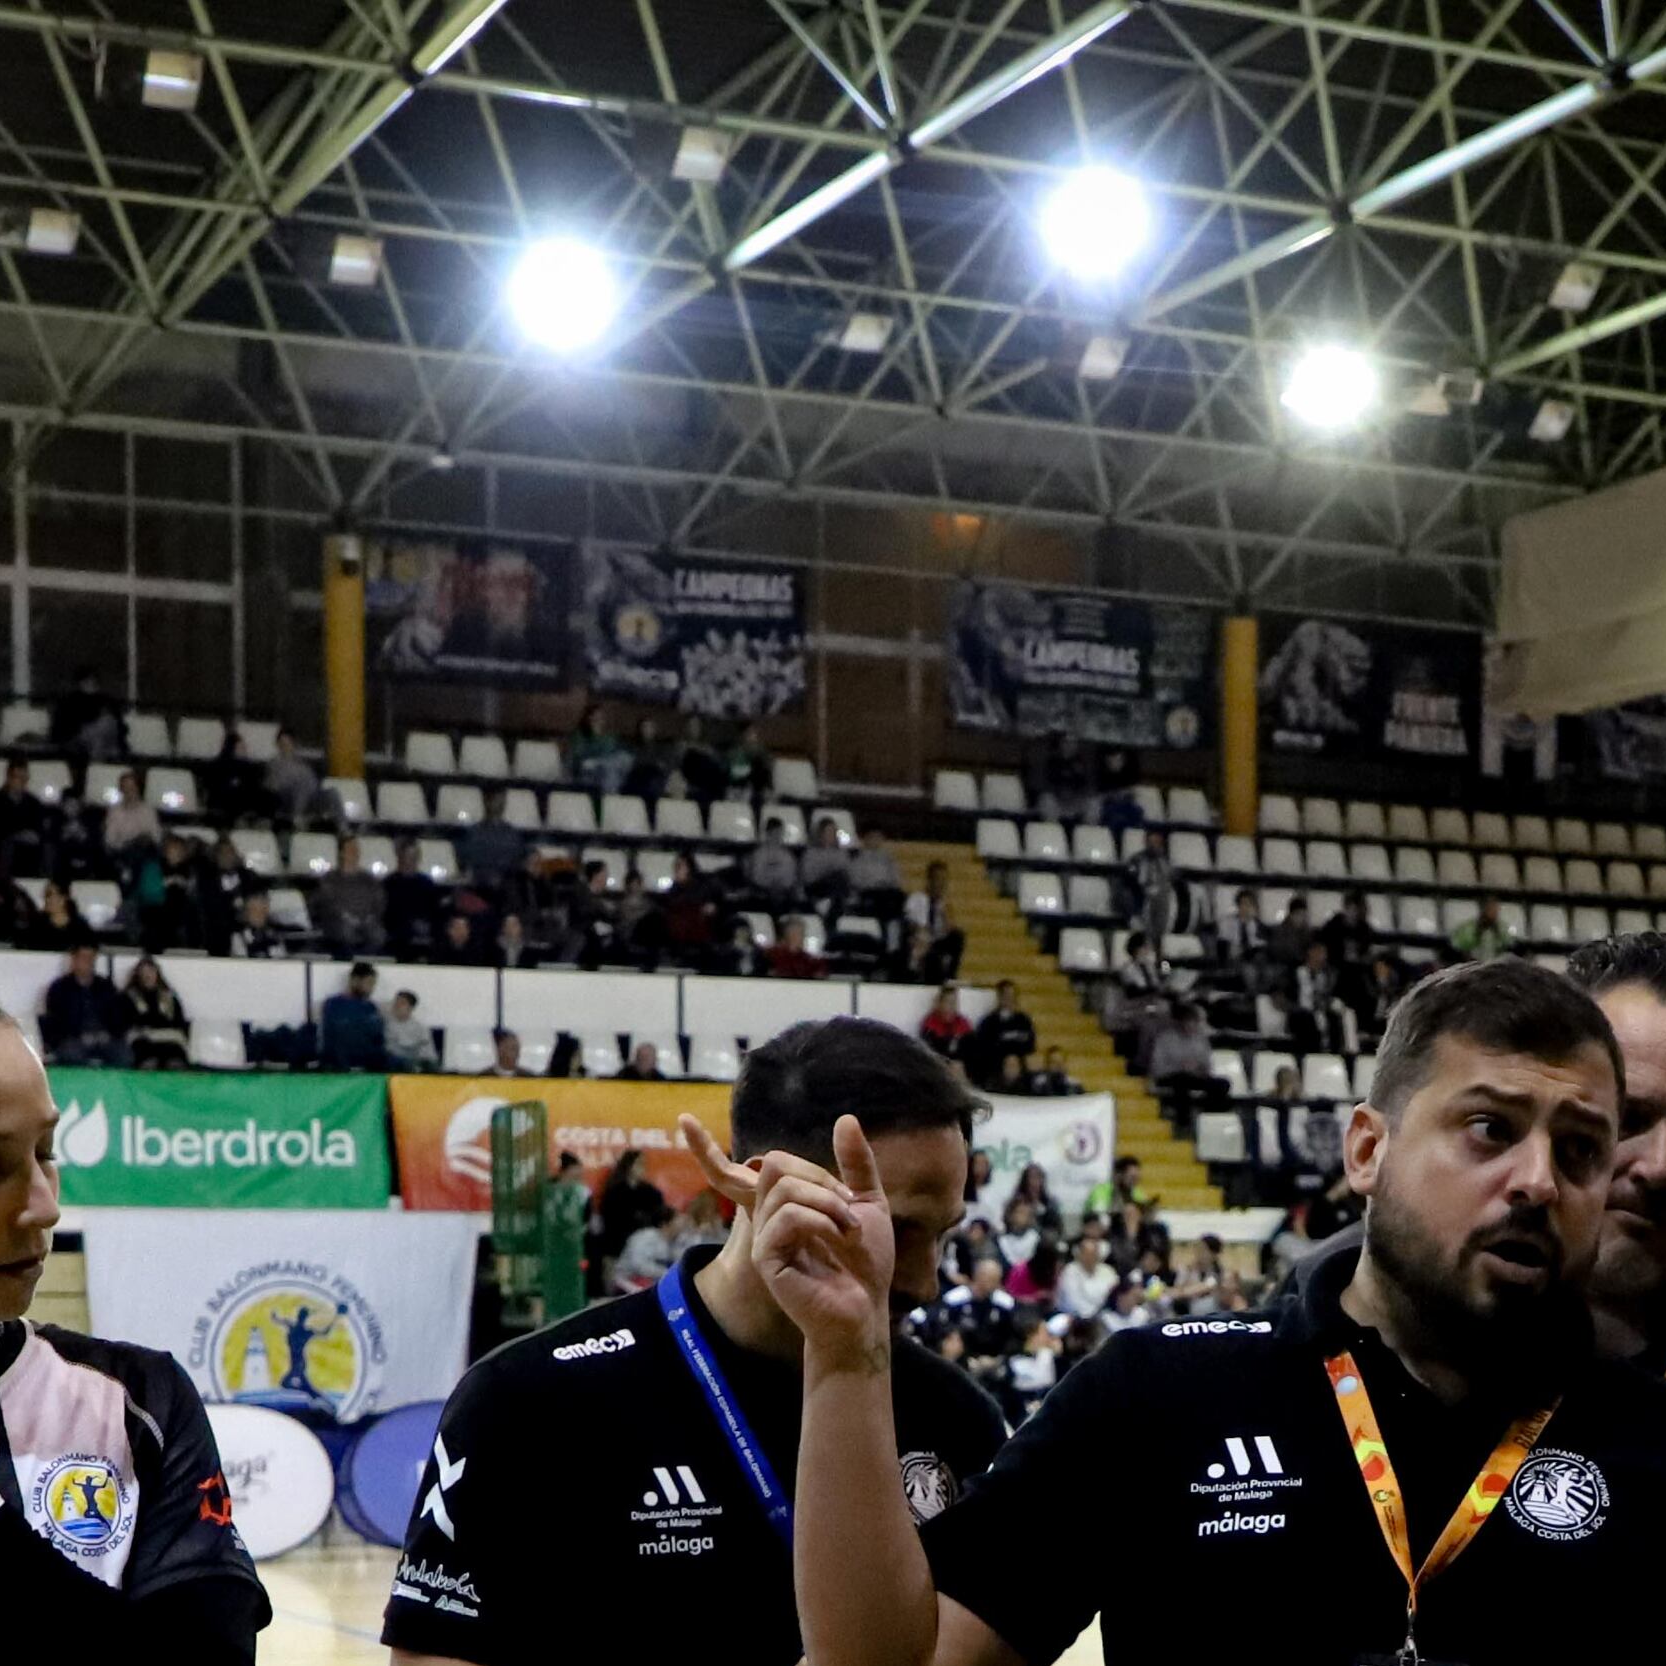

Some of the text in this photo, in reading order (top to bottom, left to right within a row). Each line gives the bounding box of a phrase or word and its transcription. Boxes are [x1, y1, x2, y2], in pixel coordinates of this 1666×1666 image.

[120, 1116, 356, 1169] Iberdrola
[206, 1261, 328, 1313] BALONMANO
[1161, 1320, 1248, 1337] emec
[553, 1334, 621, 1361] emec
[37, 1452, 99, 1485] BALONMANO
[1190, 1477, 1304, 1494] Diputación Provincial
[1218, 1493, 1233, 1503] de
[33, 1486, 43, 1513] CLUB
[681, 1505, 723, 1517] Provincial
[81, 1546, 110, 1558] COSTA
[108, 1534, 126, 1550] DEL
[120, 1513, 134, 1534] SOL
[655, 1520, 669, 1529] de
[1536, 1529, 1574, 1541] COSTA
[1573, 1526, 1594, 1540] DEL
[1589, 1515, 1607, 1531] SOL
